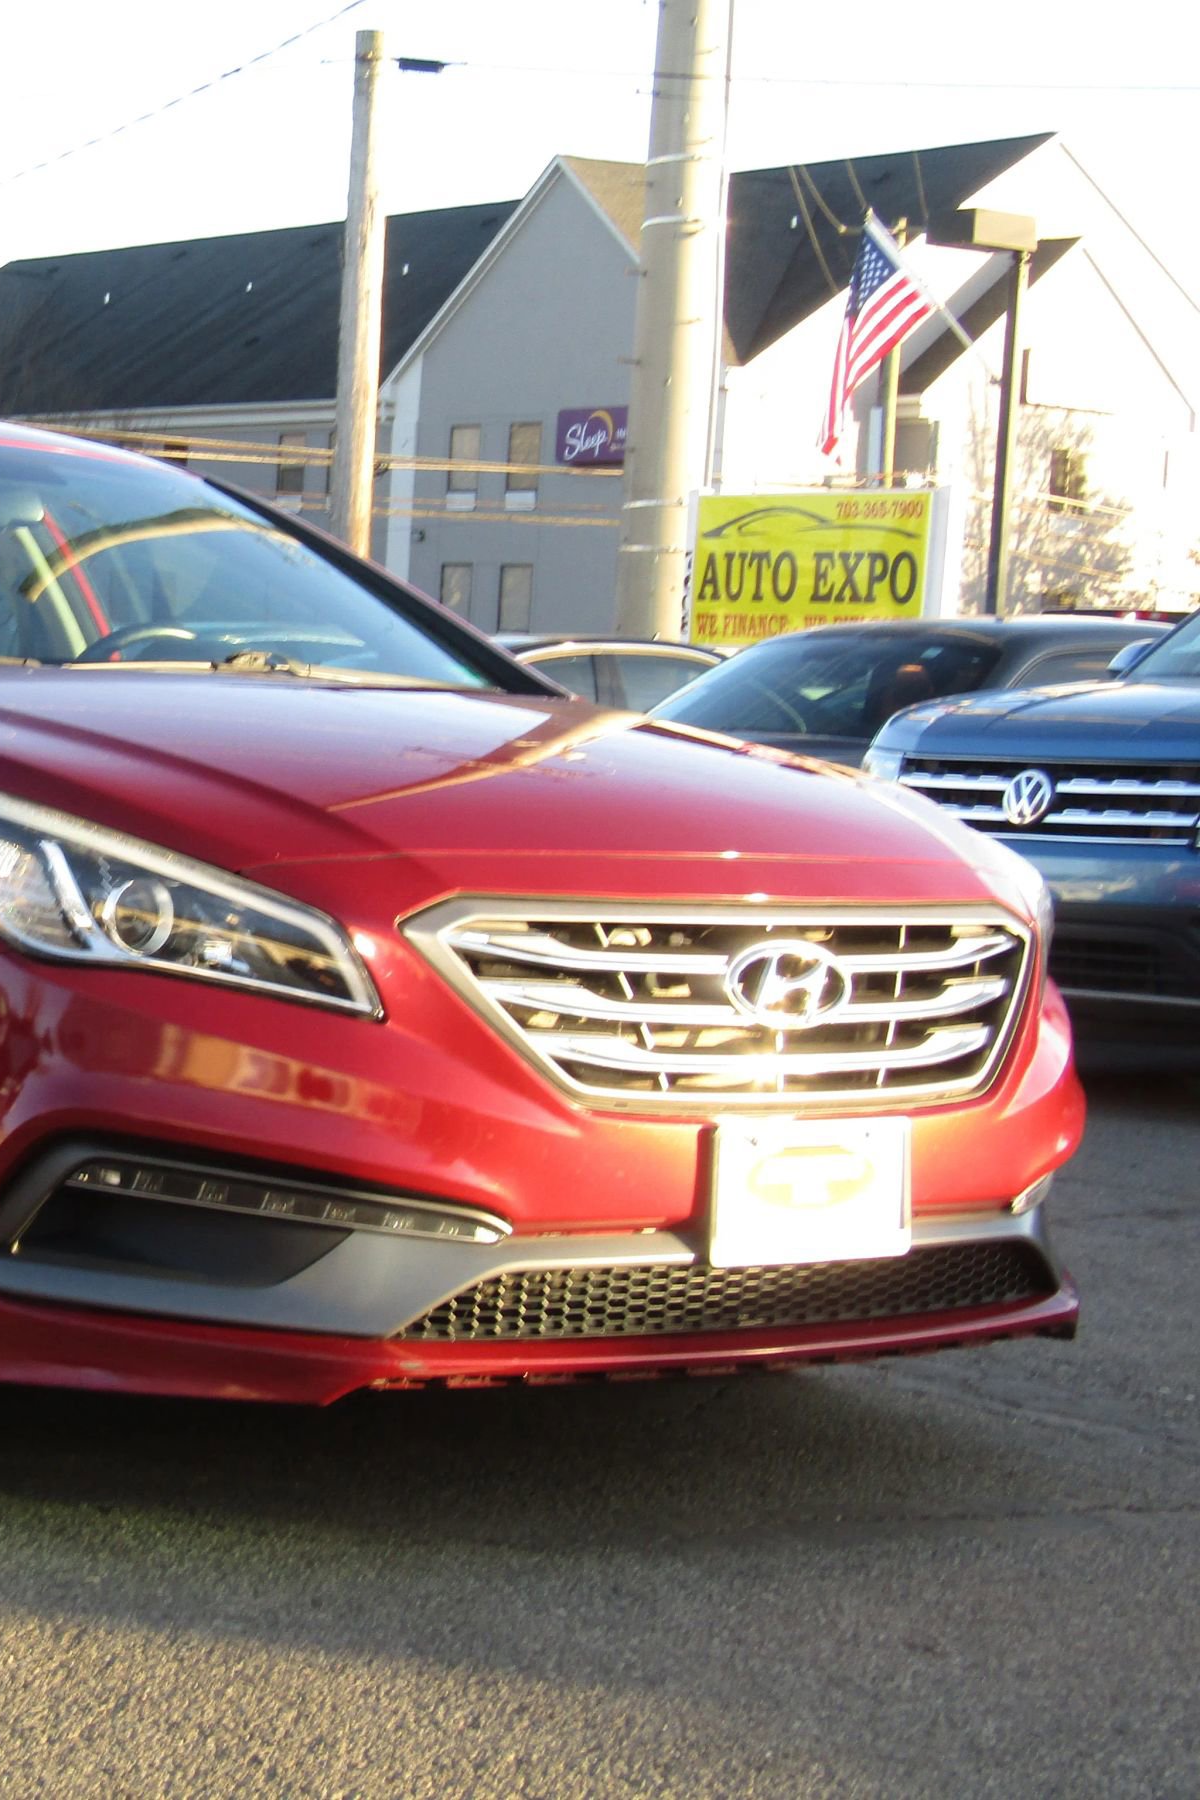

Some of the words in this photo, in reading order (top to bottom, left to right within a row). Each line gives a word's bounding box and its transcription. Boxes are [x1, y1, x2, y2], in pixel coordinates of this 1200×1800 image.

[564, 422, 608, 461] Sleep
[698, 552, 798, 603] AUTO
[810, 551, 917, 604] EXPO
[696, 613, 717, 636] WE
[722, 613, 789, 637] FINANCE
